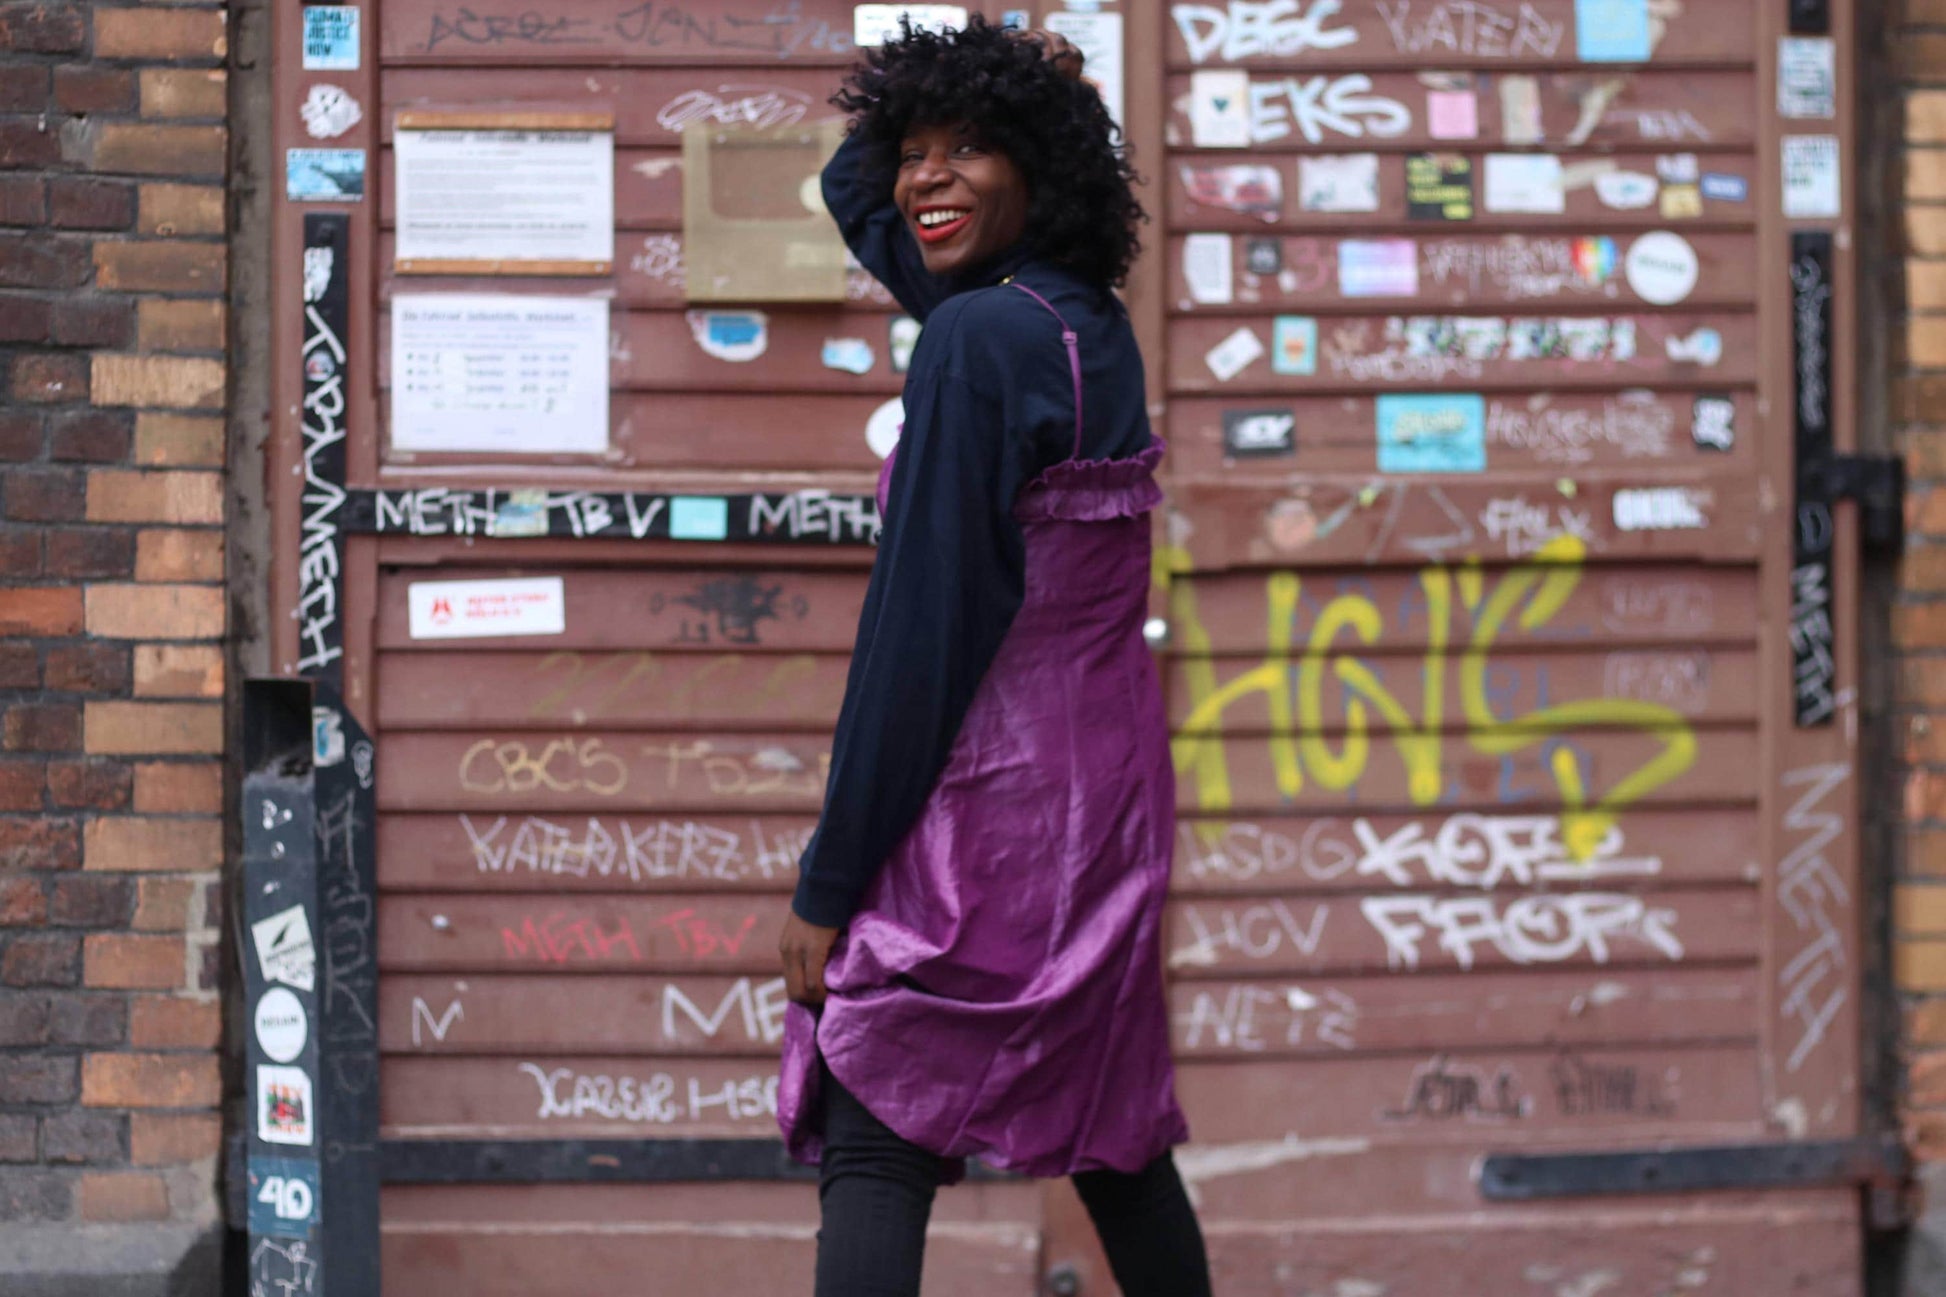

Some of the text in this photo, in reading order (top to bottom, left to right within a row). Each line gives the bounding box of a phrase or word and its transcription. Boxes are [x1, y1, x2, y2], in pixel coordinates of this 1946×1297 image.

[375, 487, 498, 537] METH
[502, 914, 642, 963] METH
[1777, 759, 1853, 1072] METH
[253, 1177, 313, 1222] 40
